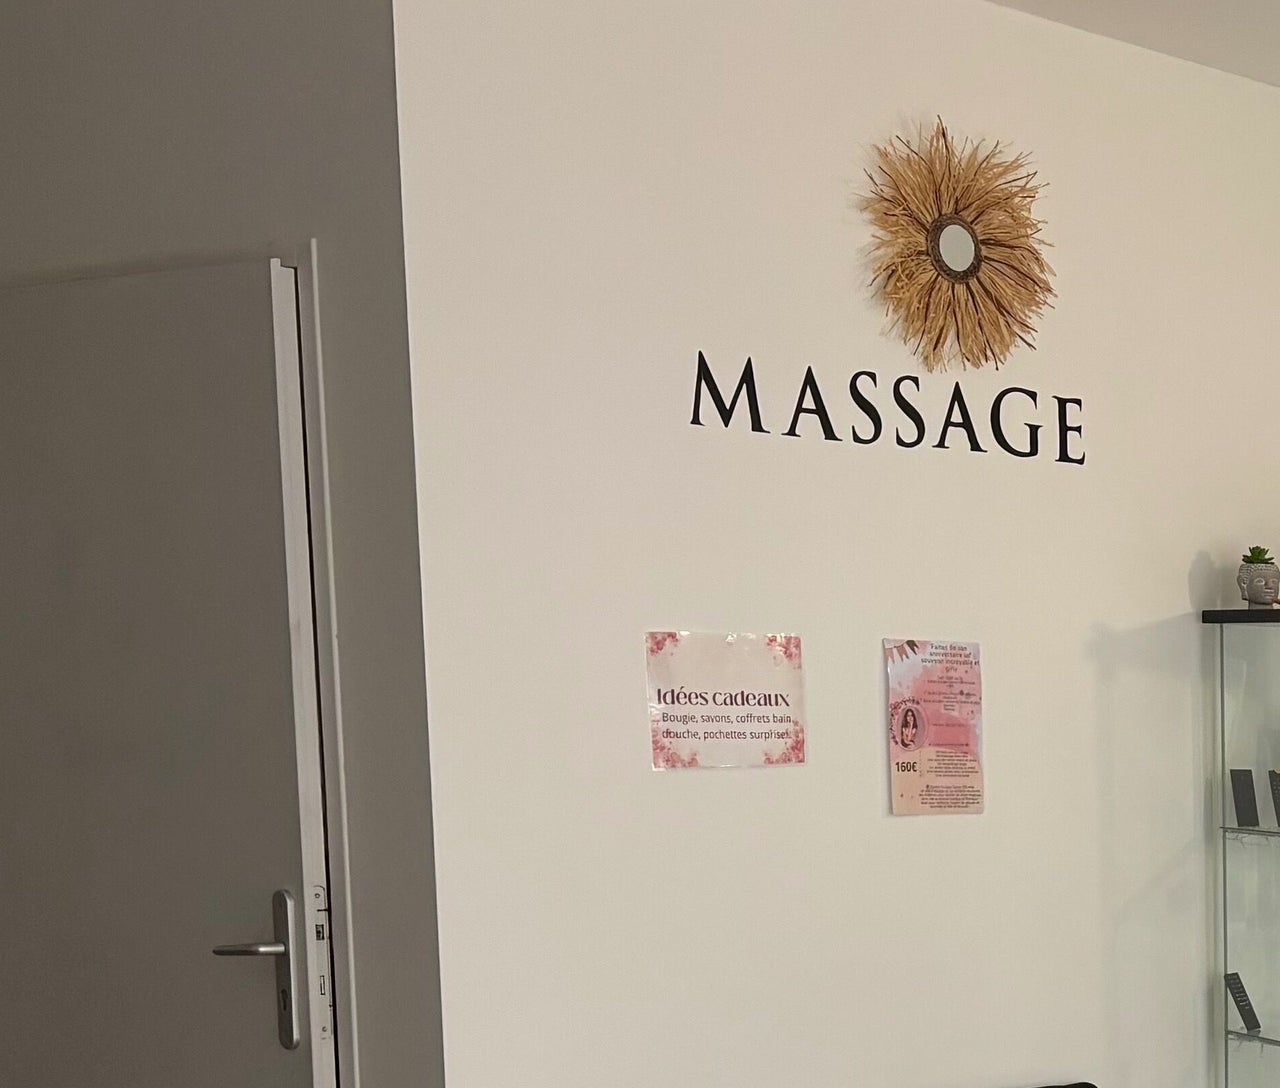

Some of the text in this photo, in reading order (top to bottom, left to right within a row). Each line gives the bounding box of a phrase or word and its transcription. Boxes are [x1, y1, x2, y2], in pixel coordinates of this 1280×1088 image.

[690, 350, 1086, 466] MASSAGE
[657, 686, 790, 707] Idées cadeaux
[662, 712, 699, 725] Bougie,
[700, 714, 734, 724] savons,
[736, 713, 770, 724] coffrets
[662, 729, 701, 740] douche,
[704, 730, 747, 741] pochettes
[896, 761, 918, 773] 160€
